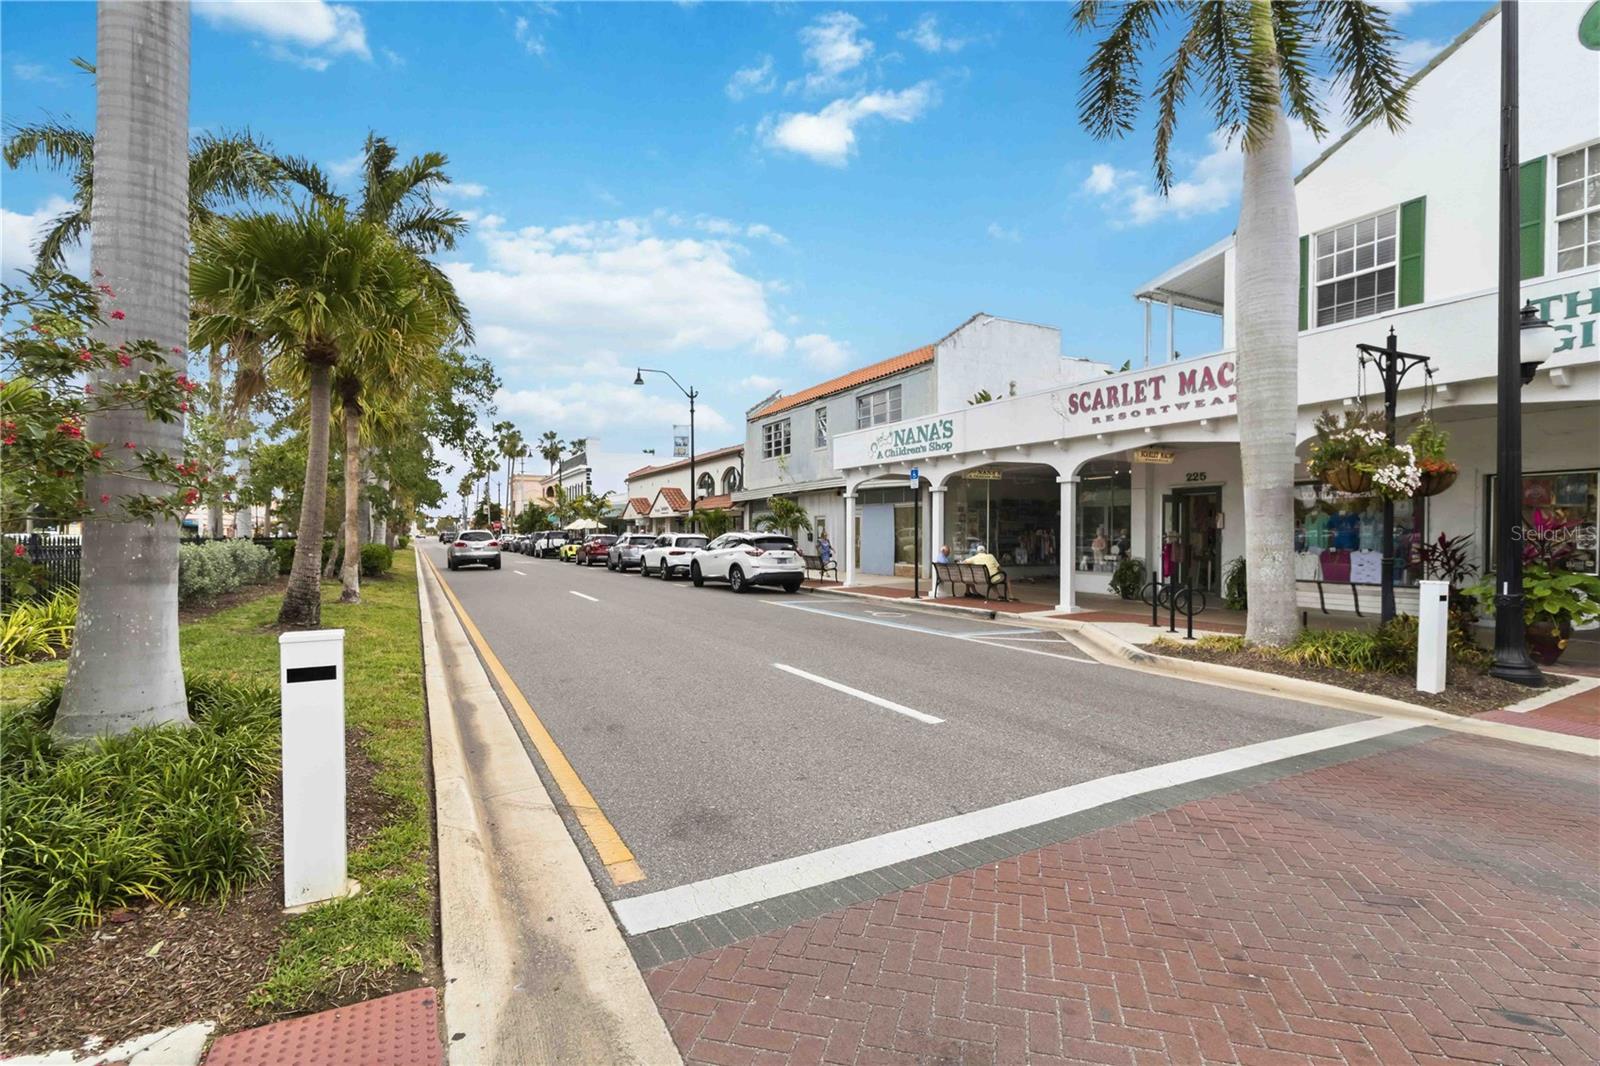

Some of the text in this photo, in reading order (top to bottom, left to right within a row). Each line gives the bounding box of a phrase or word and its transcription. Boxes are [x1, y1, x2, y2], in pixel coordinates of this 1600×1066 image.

[1529, 287, 1600, 321] TH
[1068, 375, 1166, 415] SCARLET
[894, 419, 954, 447] NANA'S
[877, 441, 953, 459] A Children's Shop
[1185, 472, 1207, 481] 225
